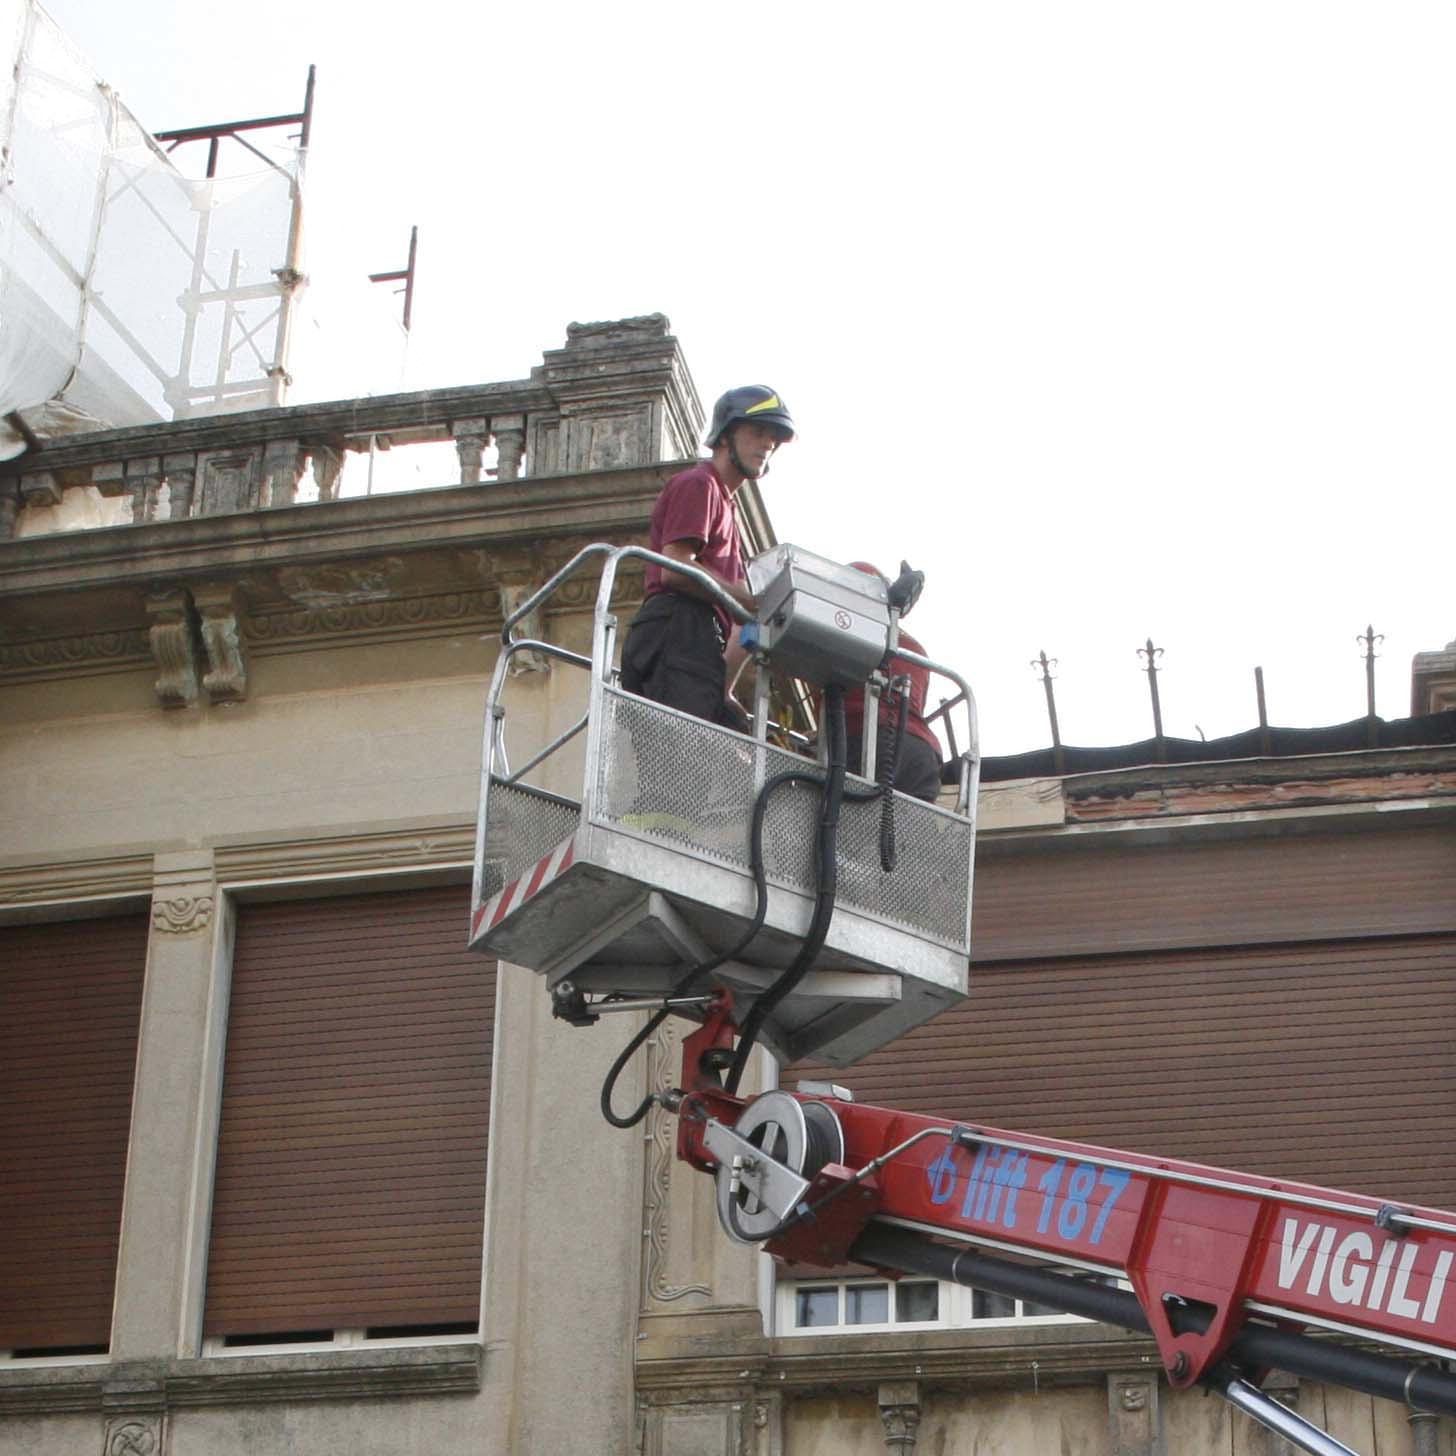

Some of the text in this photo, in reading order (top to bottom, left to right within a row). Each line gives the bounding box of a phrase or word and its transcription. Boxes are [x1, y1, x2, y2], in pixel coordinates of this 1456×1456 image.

[961, 1143, 1029, 1229] lift
[1037, 1157, 1132, 1246] 187
[1277, 1218, 1455, 1324] VIGILI
